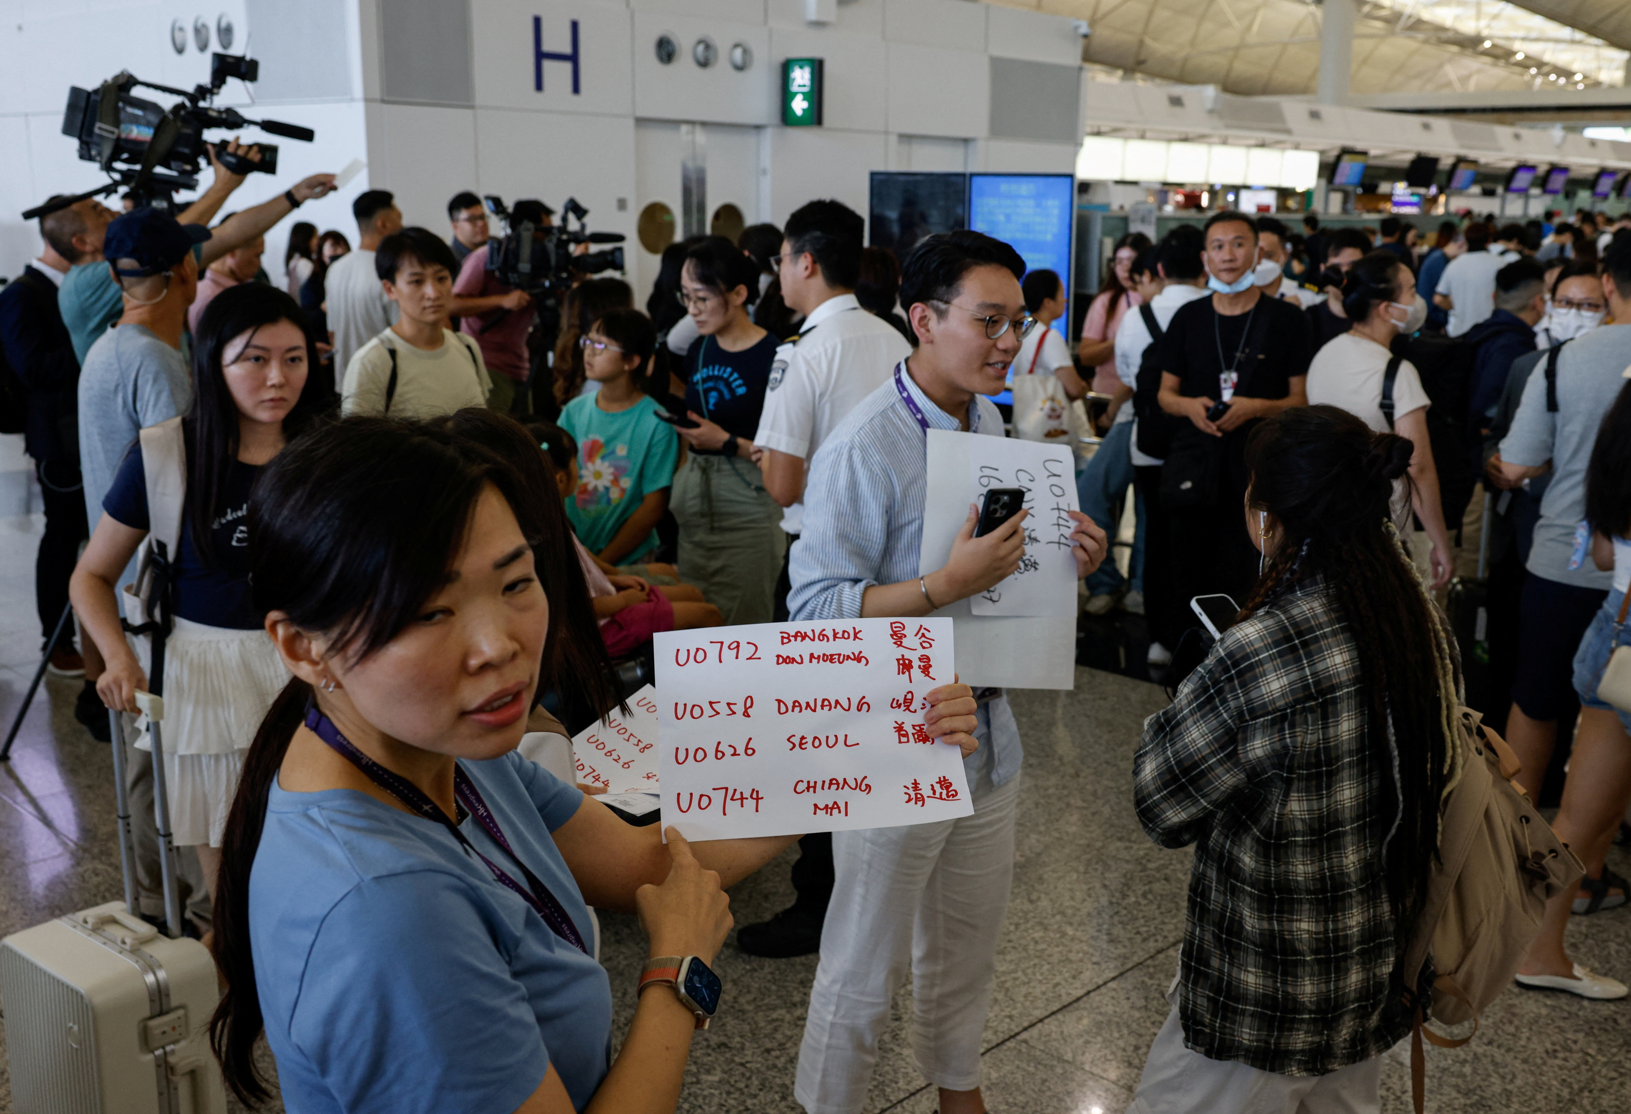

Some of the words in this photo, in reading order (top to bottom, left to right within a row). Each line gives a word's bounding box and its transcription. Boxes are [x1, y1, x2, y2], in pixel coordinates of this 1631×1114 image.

[533, 14, 580, 94] H
[779, 626, 864, 646] BANGKOK
[889, 620, 936, 651] 曼谷
[775, 653, 804, 667] DON
[775, 695, 872, 716] DANANG
[889, 690, 933, 714] 峴
[786, 733, 860, 751] SEOUL
[793, 775, 873, 796] CHIANG
[812, 800, 849, 817] MAI
